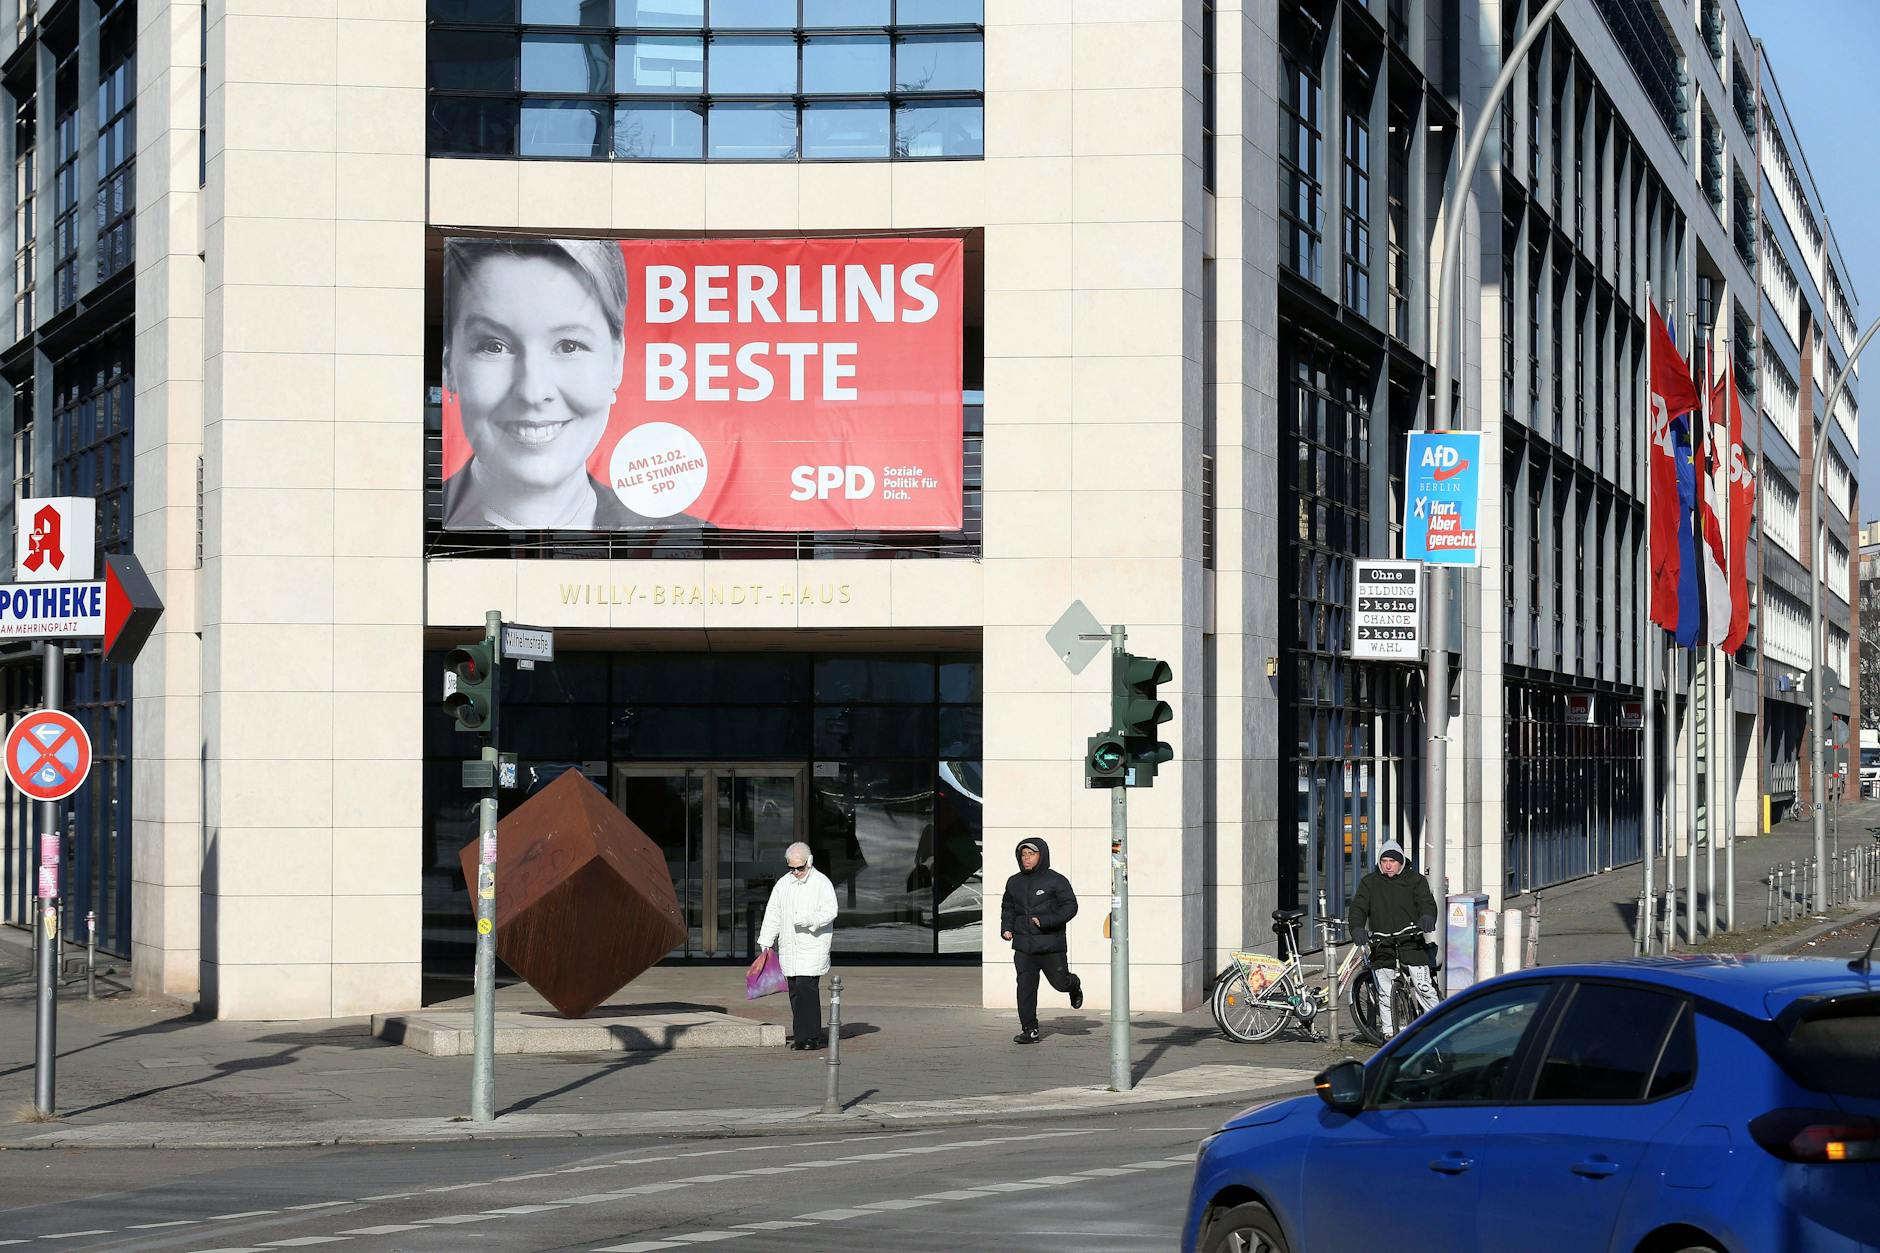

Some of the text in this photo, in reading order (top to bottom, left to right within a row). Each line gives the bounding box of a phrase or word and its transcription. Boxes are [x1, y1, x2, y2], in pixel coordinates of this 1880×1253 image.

[645, 263, 939, 323] BERLINS
[645, 342, 857, 402] BESTE
[628, 449, 686, 472] AM 12.02.
[1421, 445, 1459, 467] AfD
[617, 458, 704, 489] ALLE STIMMEN
[883, 466, 923, 476] Soziale
[652, 480, 675, 494] SPD
[790, 465, 875, 501] SPD
[883, 478, 938, 488] Politik für
[1420, 483, 1460, 492] BERLIN
[883, 490, 911, 500] Dich.
[1430, 500, 1457, 515] Hart.
[1430, 516, 1456, 530] Aber
[1429, 532, 1476, 549] gerecht.
[1371, 570, 1403, 580] Ohne
[560, 584, 851, 605] WILLY-BRANDT-HAUS
[1359, 585, 1414, 596] BILDUNG
[1374, 600, 1414, 610] keine
[1363, 614, 1411, 624] CHANCE
[1, 622, 77, 634] AM MEHRINGPLATZ
[1374, 629, 1414, 639] keine
[506, 631, 548, 654] Wilhelmstraße
[1370, 642, 1402, 652] WAHL
